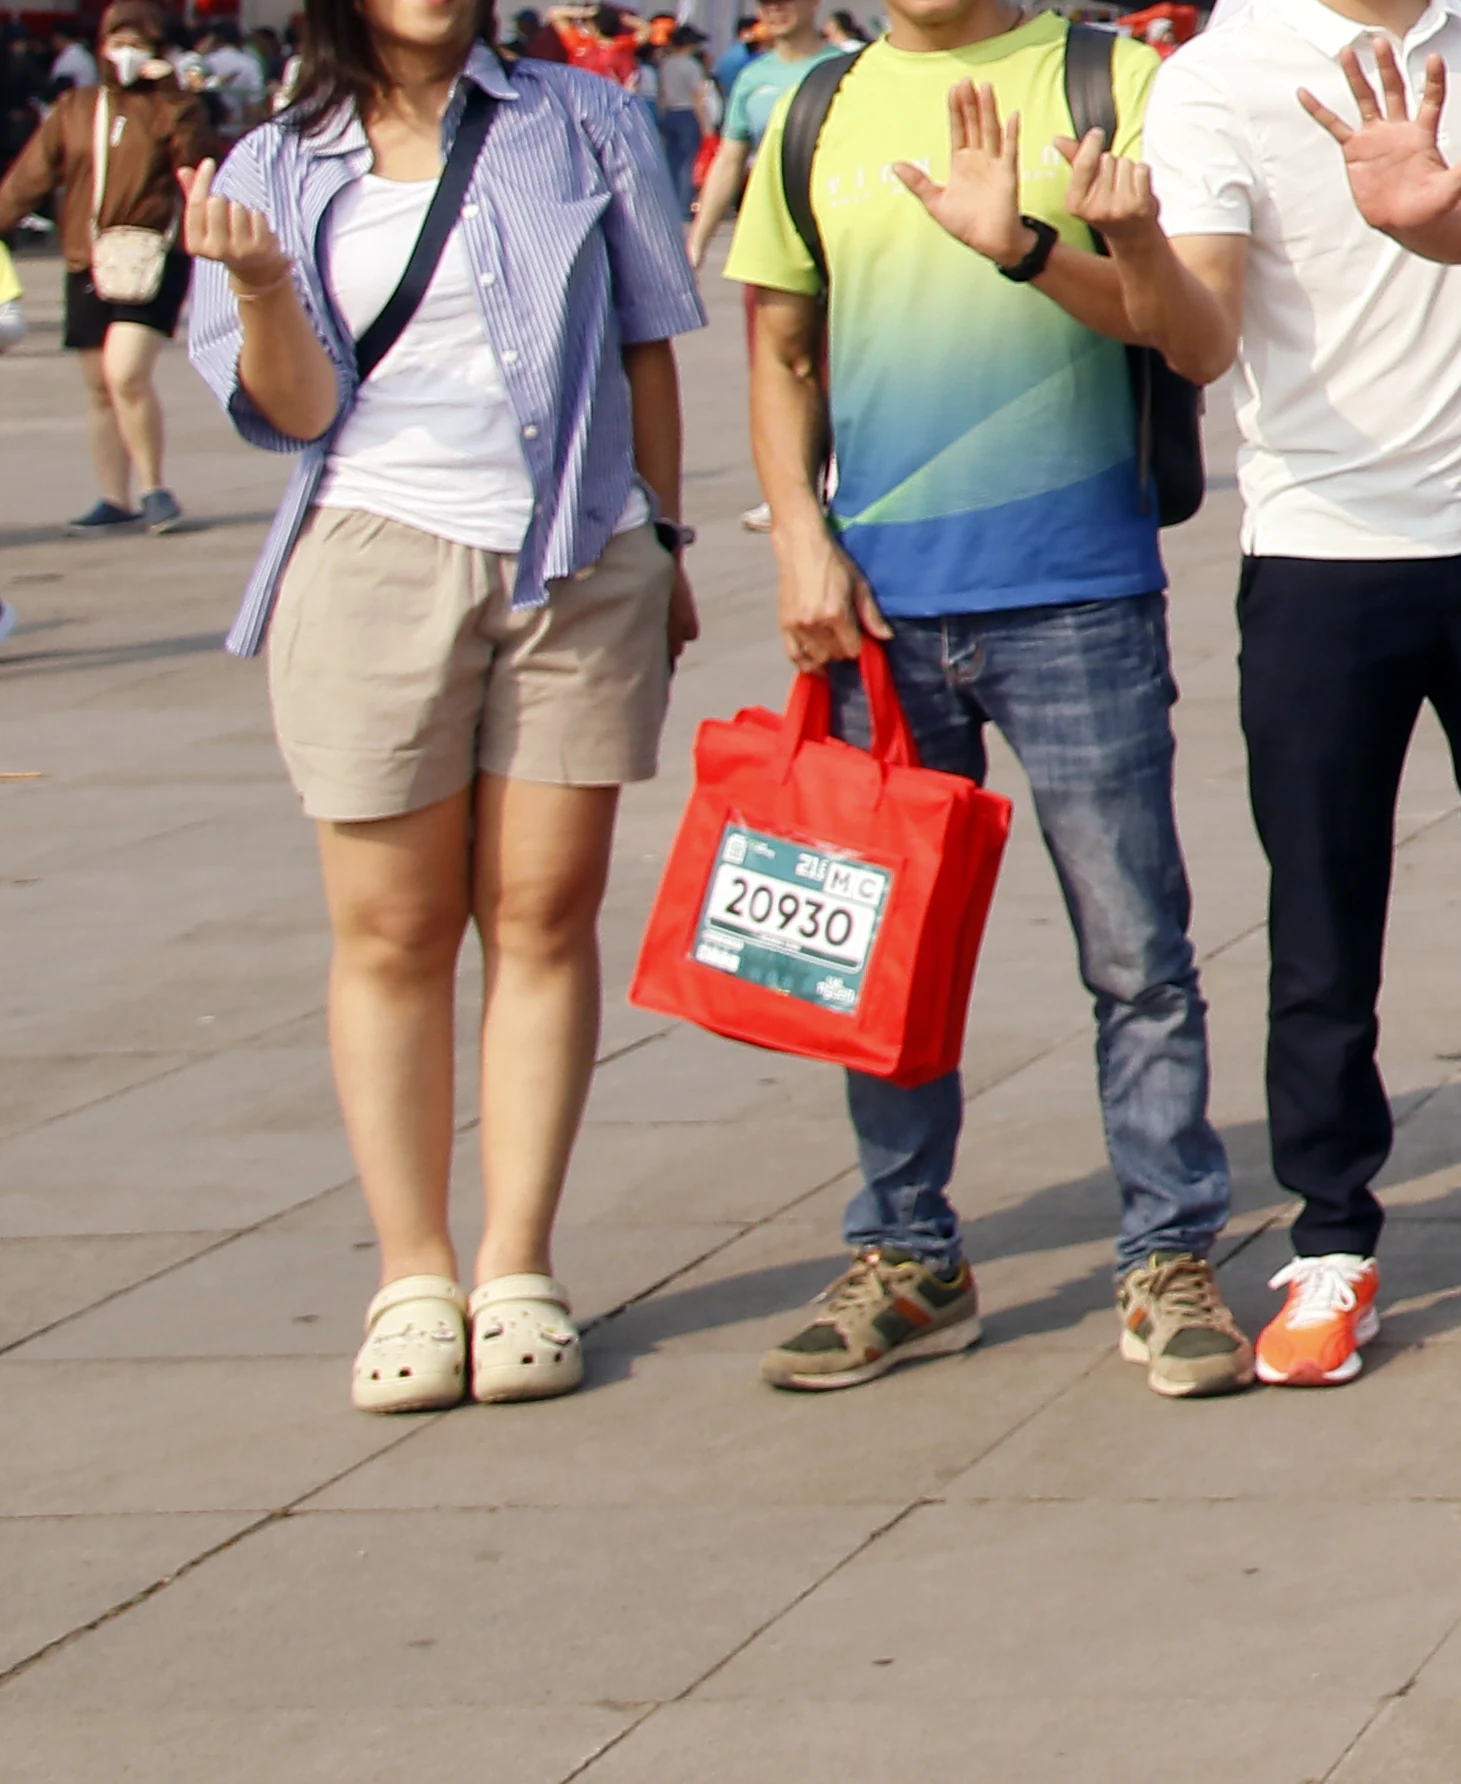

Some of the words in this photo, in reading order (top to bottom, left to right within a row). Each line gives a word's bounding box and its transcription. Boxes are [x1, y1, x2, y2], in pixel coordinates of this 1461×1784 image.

[830, 872, 849, 893] M
[858, 878, 876, 899] C
[724, 877, 855, 947] 20930
